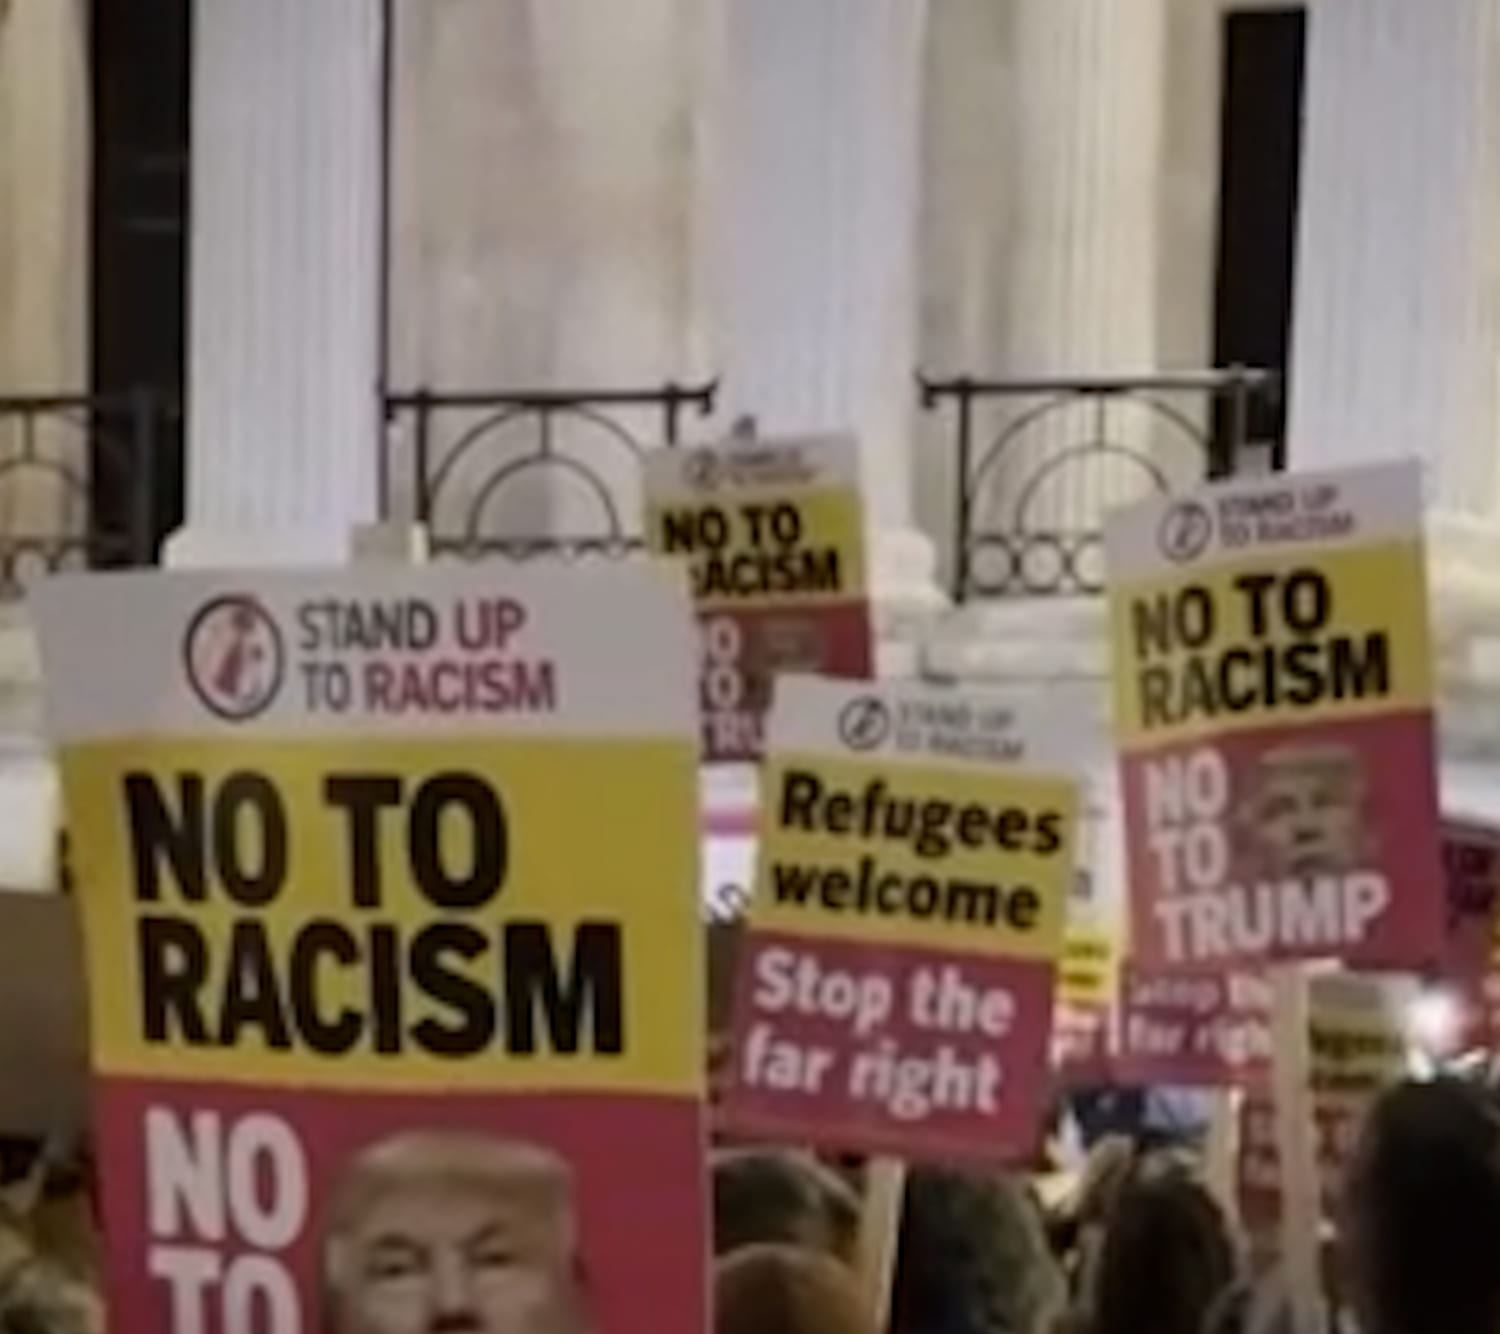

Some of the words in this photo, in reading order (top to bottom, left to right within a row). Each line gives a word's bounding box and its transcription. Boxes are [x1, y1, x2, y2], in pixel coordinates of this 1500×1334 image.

[740, 500, 802, 547] TO
[298, 599, 438, 651] STAND
[454, 600, 526, 651] UP
[1131, 584, 1215, 660] NO
[1232, 568, 1331, 638] TO
[300, 662, 353, 713] TO
[364, 660, 556, 713] RACISM
[1138, 631, 1390, 730] RACISM
[779, 770, 1062, 858] Refugees
[1143, 747, 1228, 826] NO
[123, 770, 288, 906] NO
[323, 771, 508, 909] TO
[1149, 822, 1229, 893] TO
[772, 856, 1041, 930] welcome
[1154, 870, 1391, 961] TRUMP
[137, 916, 625, 1058] RACISM
[753, 947, 893, 1036] Stop
[910, 966, 1016, 1035] the
[742, 1022, 834, 1094] far
[849, 1040, 1001, 1121] right
[145, 1107, 308, 1248] NO
